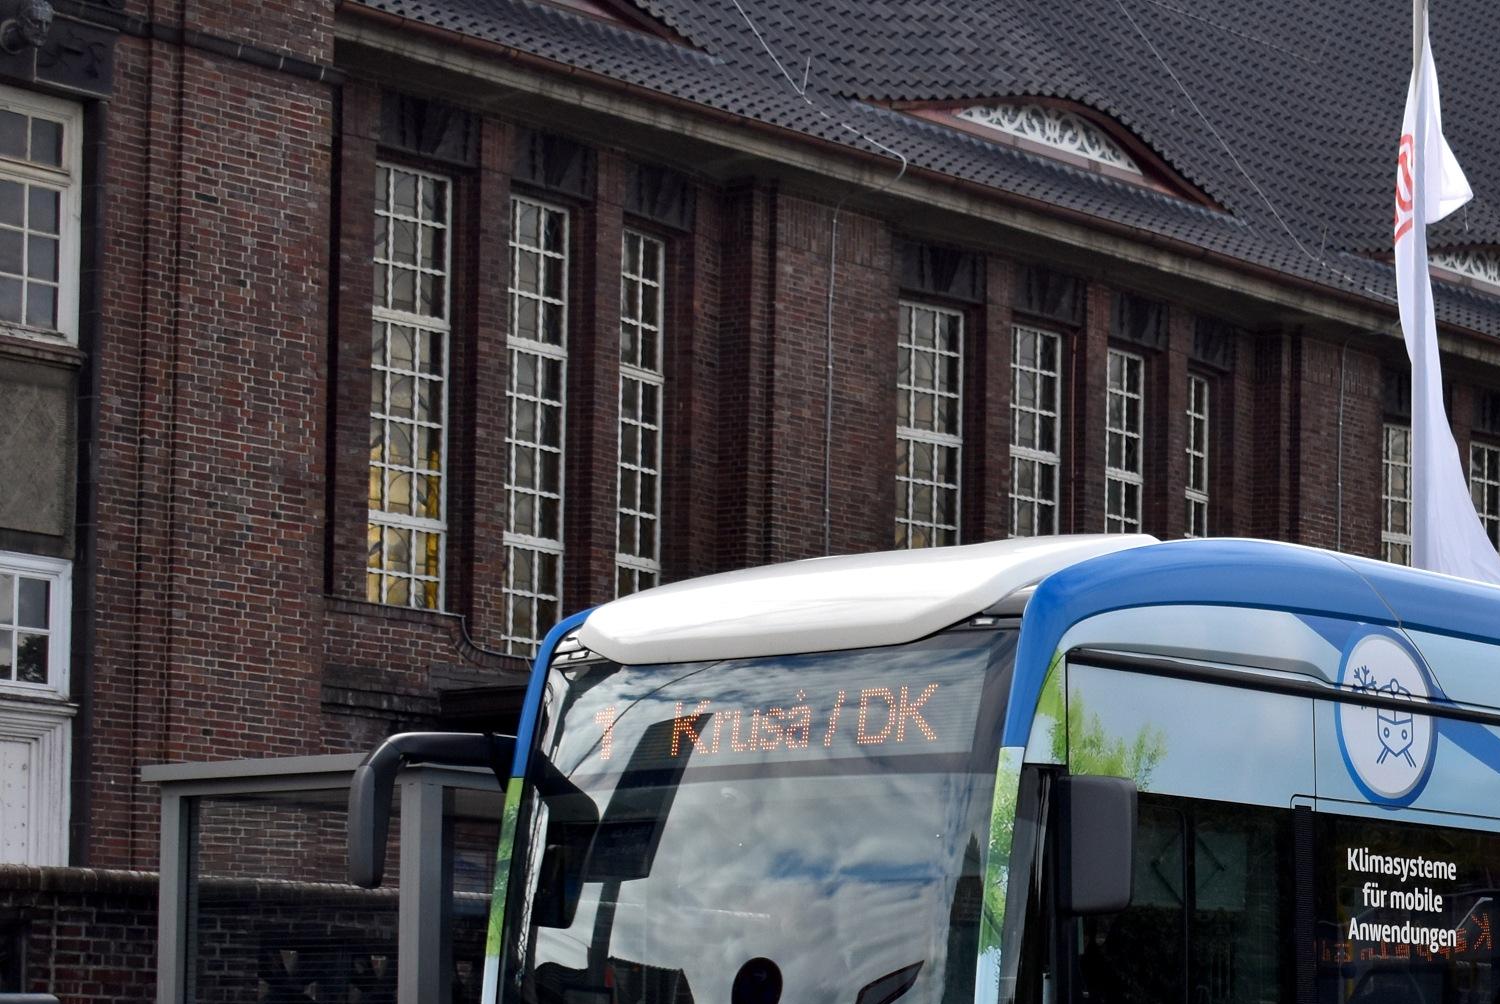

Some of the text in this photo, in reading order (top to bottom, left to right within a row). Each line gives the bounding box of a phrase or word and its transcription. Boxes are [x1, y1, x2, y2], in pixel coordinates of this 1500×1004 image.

[595, 683, 939, 760] 1 Kruså / DK
[1347, 847, 1457, 882] Klimasysteme
[1362, 882, 1443, 913] für mobile
[1348, 917, 1457, 953] Anwendungen
